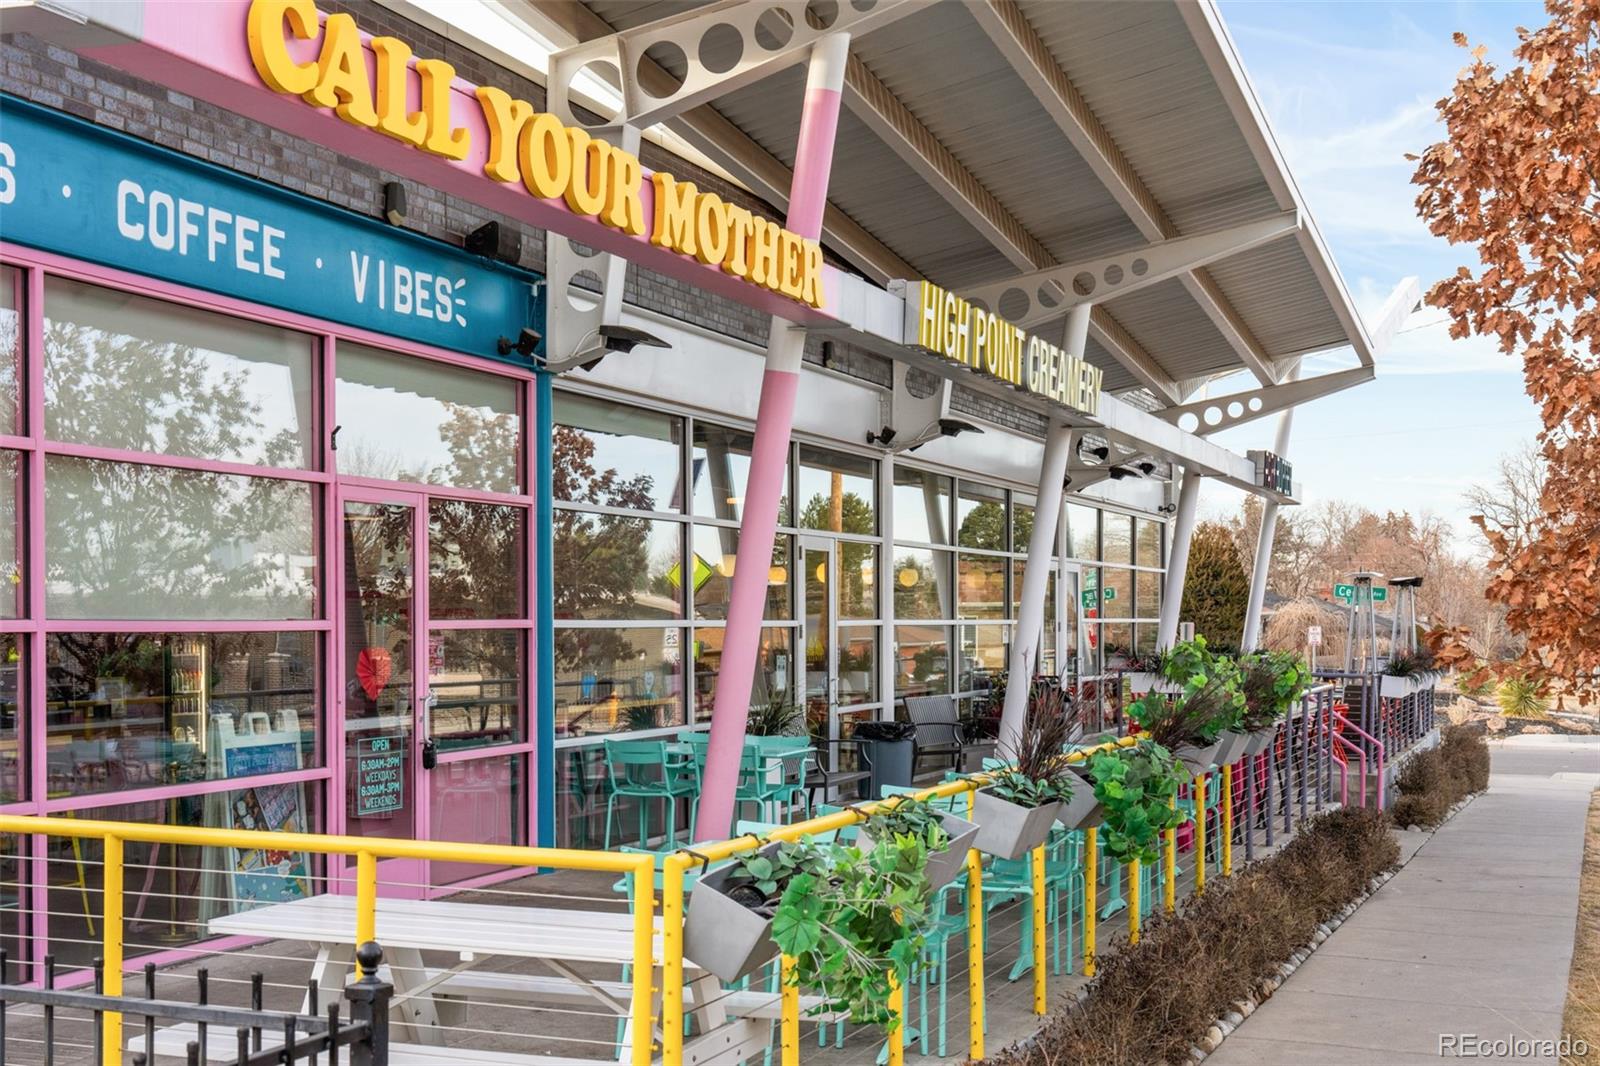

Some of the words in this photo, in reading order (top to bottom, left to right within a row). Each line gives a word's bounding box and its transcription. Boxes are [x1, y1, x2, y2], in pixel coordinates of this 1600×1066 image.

[247, 0, 470, 160] CALL
[476, 86, 646, 236] YOUR
[650, 172, 825, 309] MOTHER
[116, 179, 286, 280] COFFEE
[350, 250, 452, 326] VIBES
[919, 280, 971, 365] HIGH
[972, 308, 1027, 386] POINT
[1026, 335, 1104, 417] CREAMERY
[365, 769, 397, 783] WEEKDAYS
[372, 738, 390, 752] OPEN
[365, 794, 397, 809] WEEKENDS
